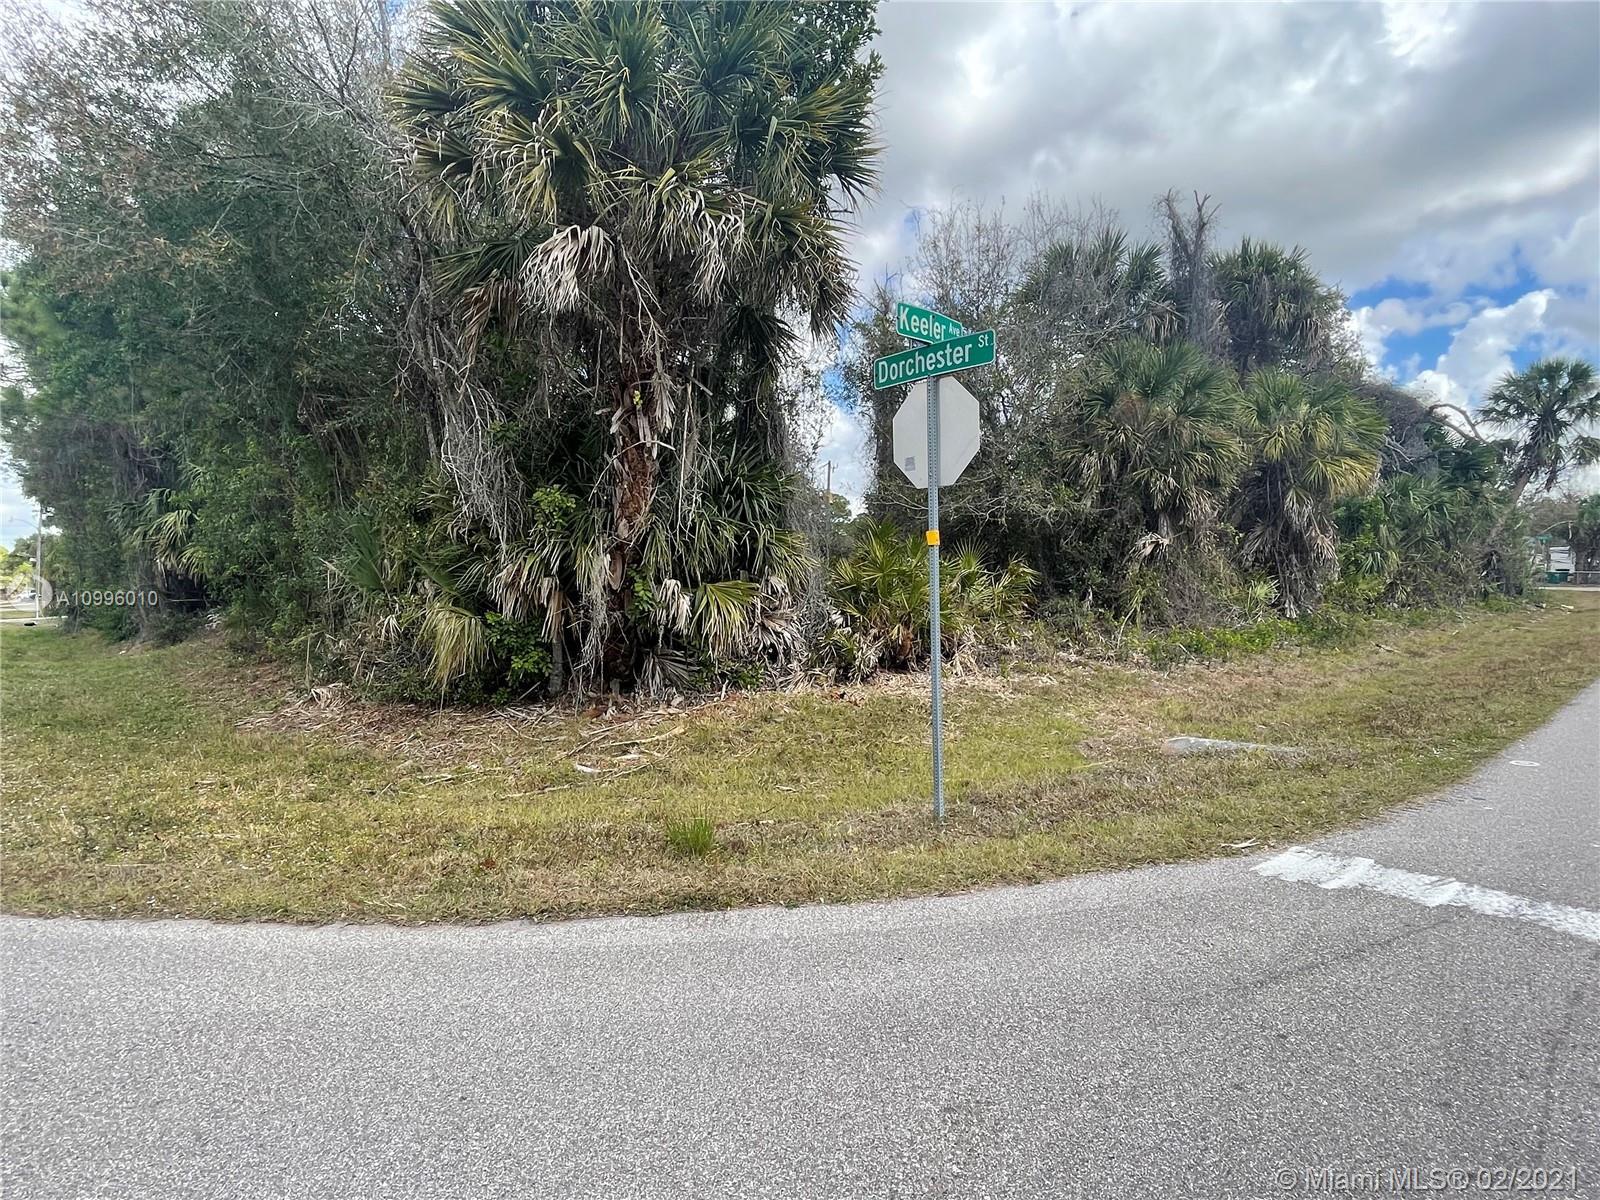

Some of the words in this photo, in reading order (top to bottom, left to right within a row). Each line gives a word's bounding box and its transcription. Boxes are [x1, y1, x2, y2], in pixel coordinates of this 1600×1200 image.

[900, 306, 946, 341] Keeler
[948, 322, 961, 337] Ave
[878, 342, 972, 383] Dorchester
[978, 334, 989, 348] St
